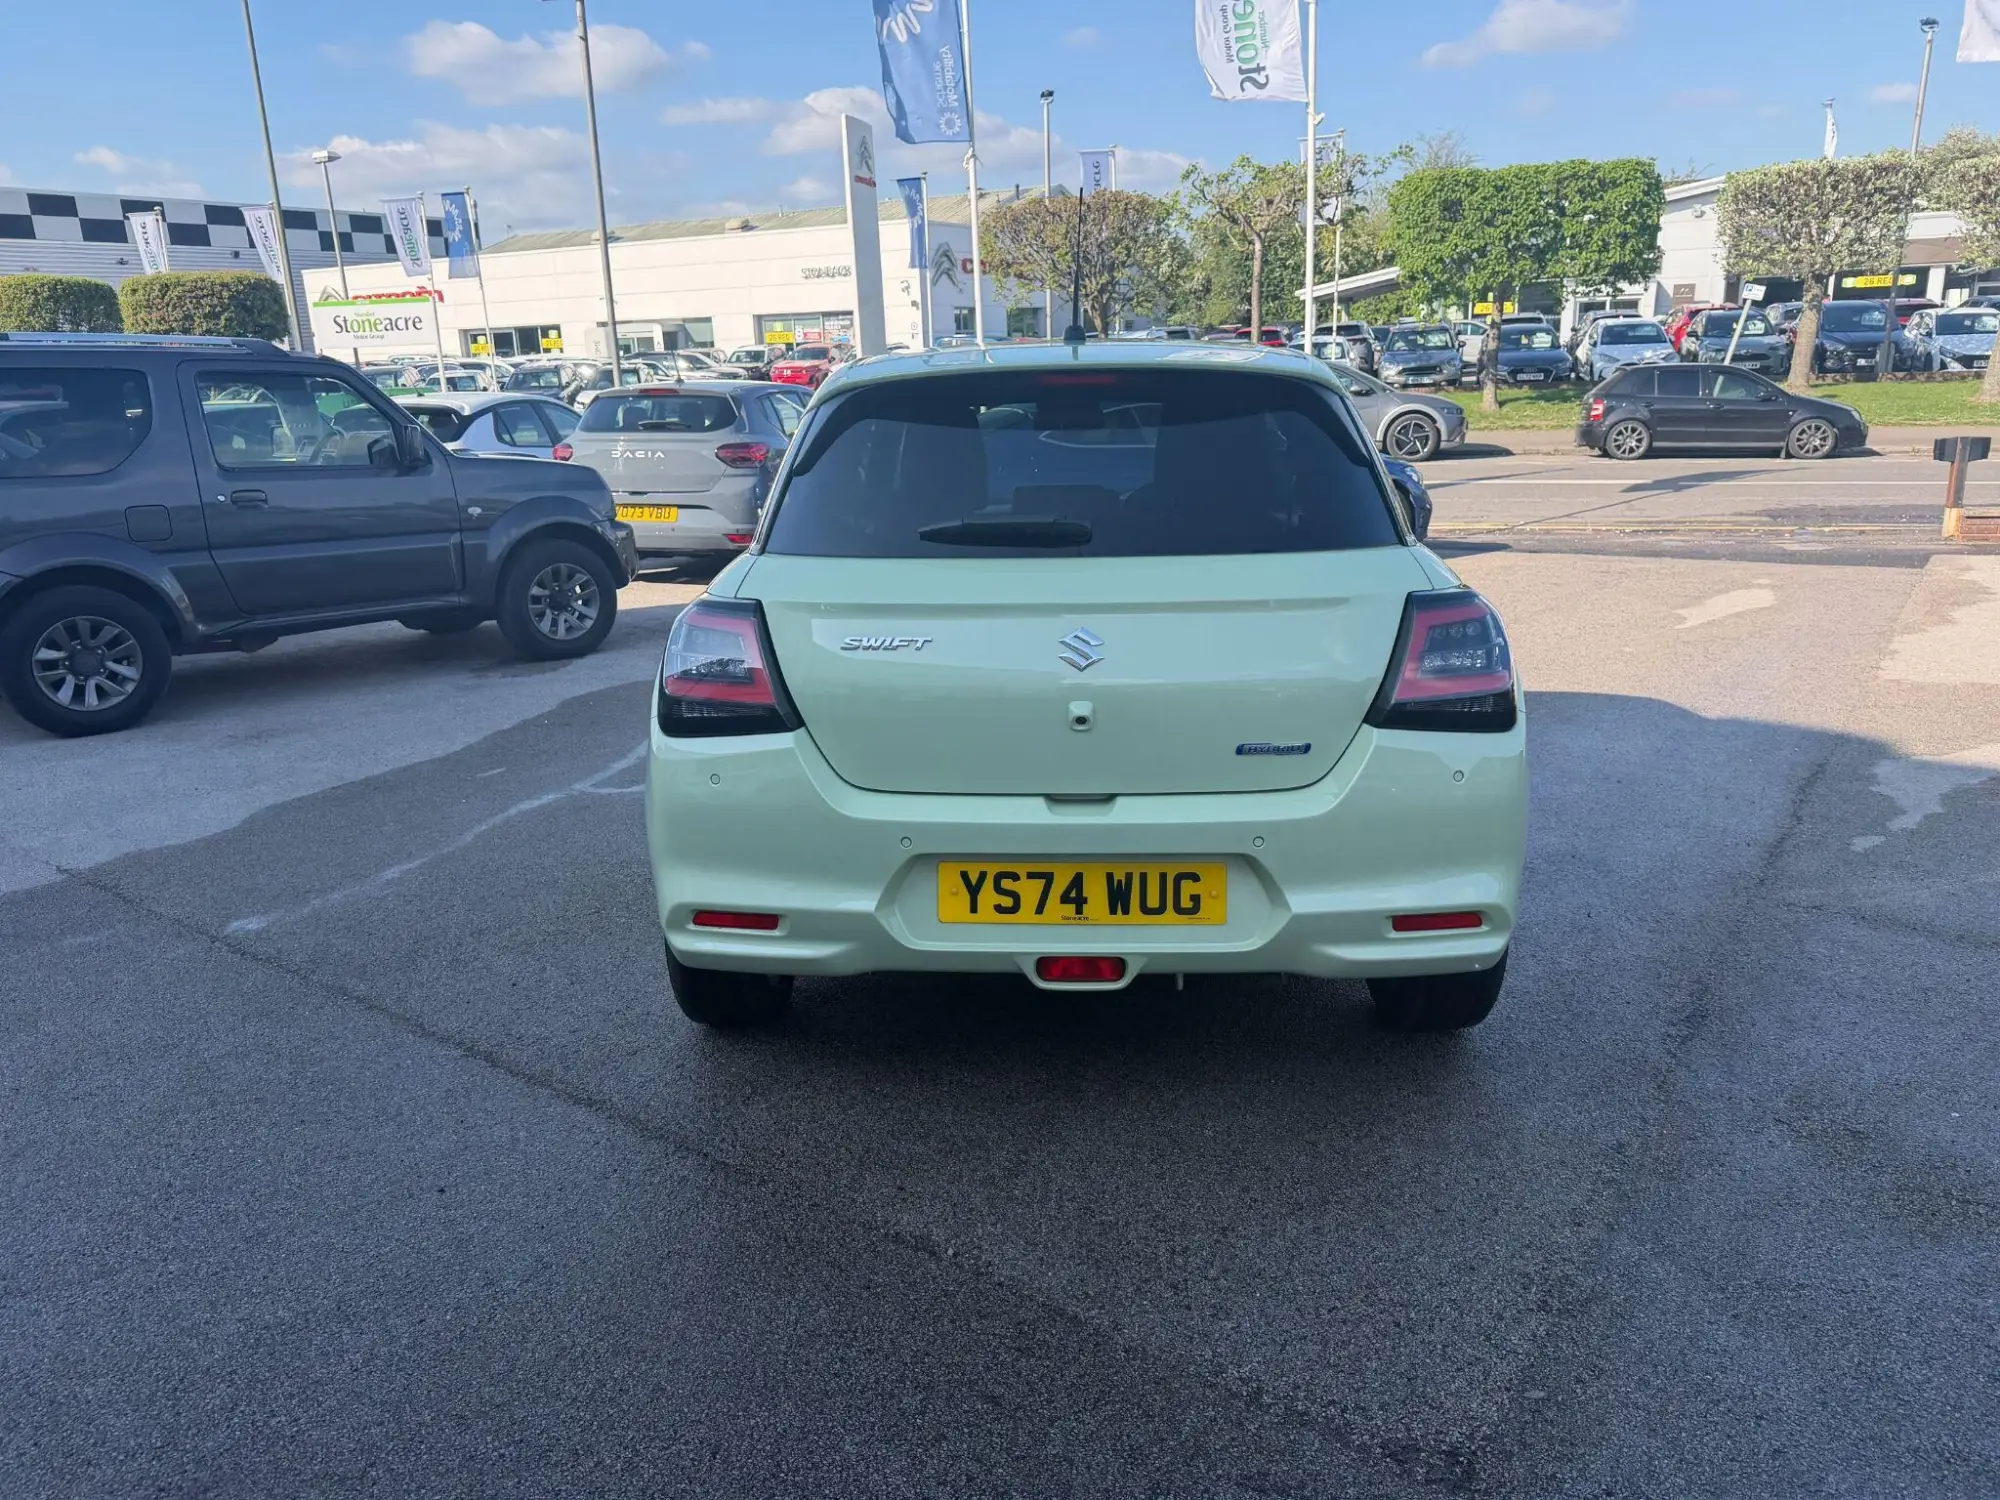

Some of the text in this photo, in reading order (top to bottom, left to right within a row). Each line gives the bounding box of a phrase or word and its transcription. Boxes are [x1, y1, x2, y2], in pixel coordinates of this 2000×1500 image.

[333, 314, 422, 334] Stoneacre
[611, 450, 665, 458] DACIA
[840, 636, 933, 651] SWIFT
[960, 870, 1201, 915] YS74 WUG
